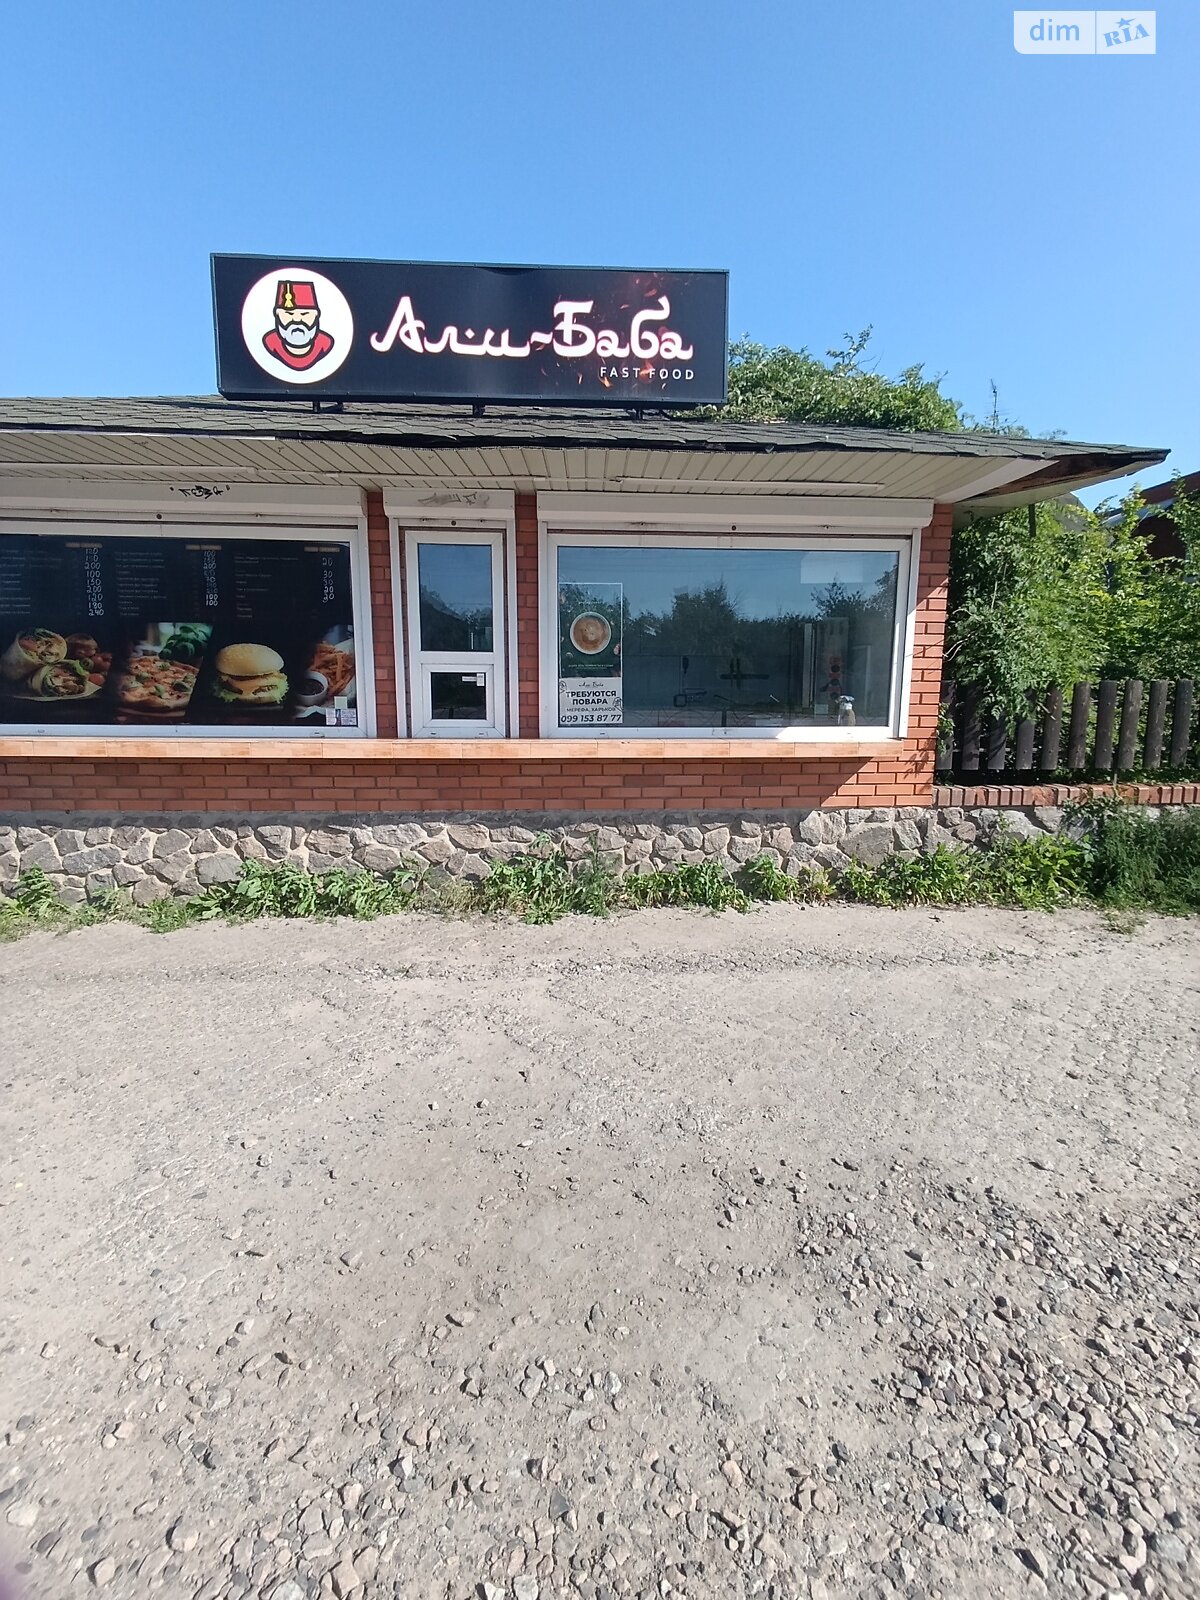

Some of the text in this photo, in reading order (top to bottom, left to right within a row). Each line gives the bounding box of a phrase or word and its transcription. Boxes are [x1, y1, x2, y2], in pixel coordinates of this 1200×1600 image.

[600, 366, 694, 380] FAST FOOD
[84, 562, 101, 570] 200
[86, 570, 101, 578] 100
[86, 585, 102, 593] 200
[565, 690, 617, 698] ТРЕБУЮТСЯ
[560, 715, 578, 723] 099
[597, 714, 609, 722] 87
[611, 714, 622, 722] 77
